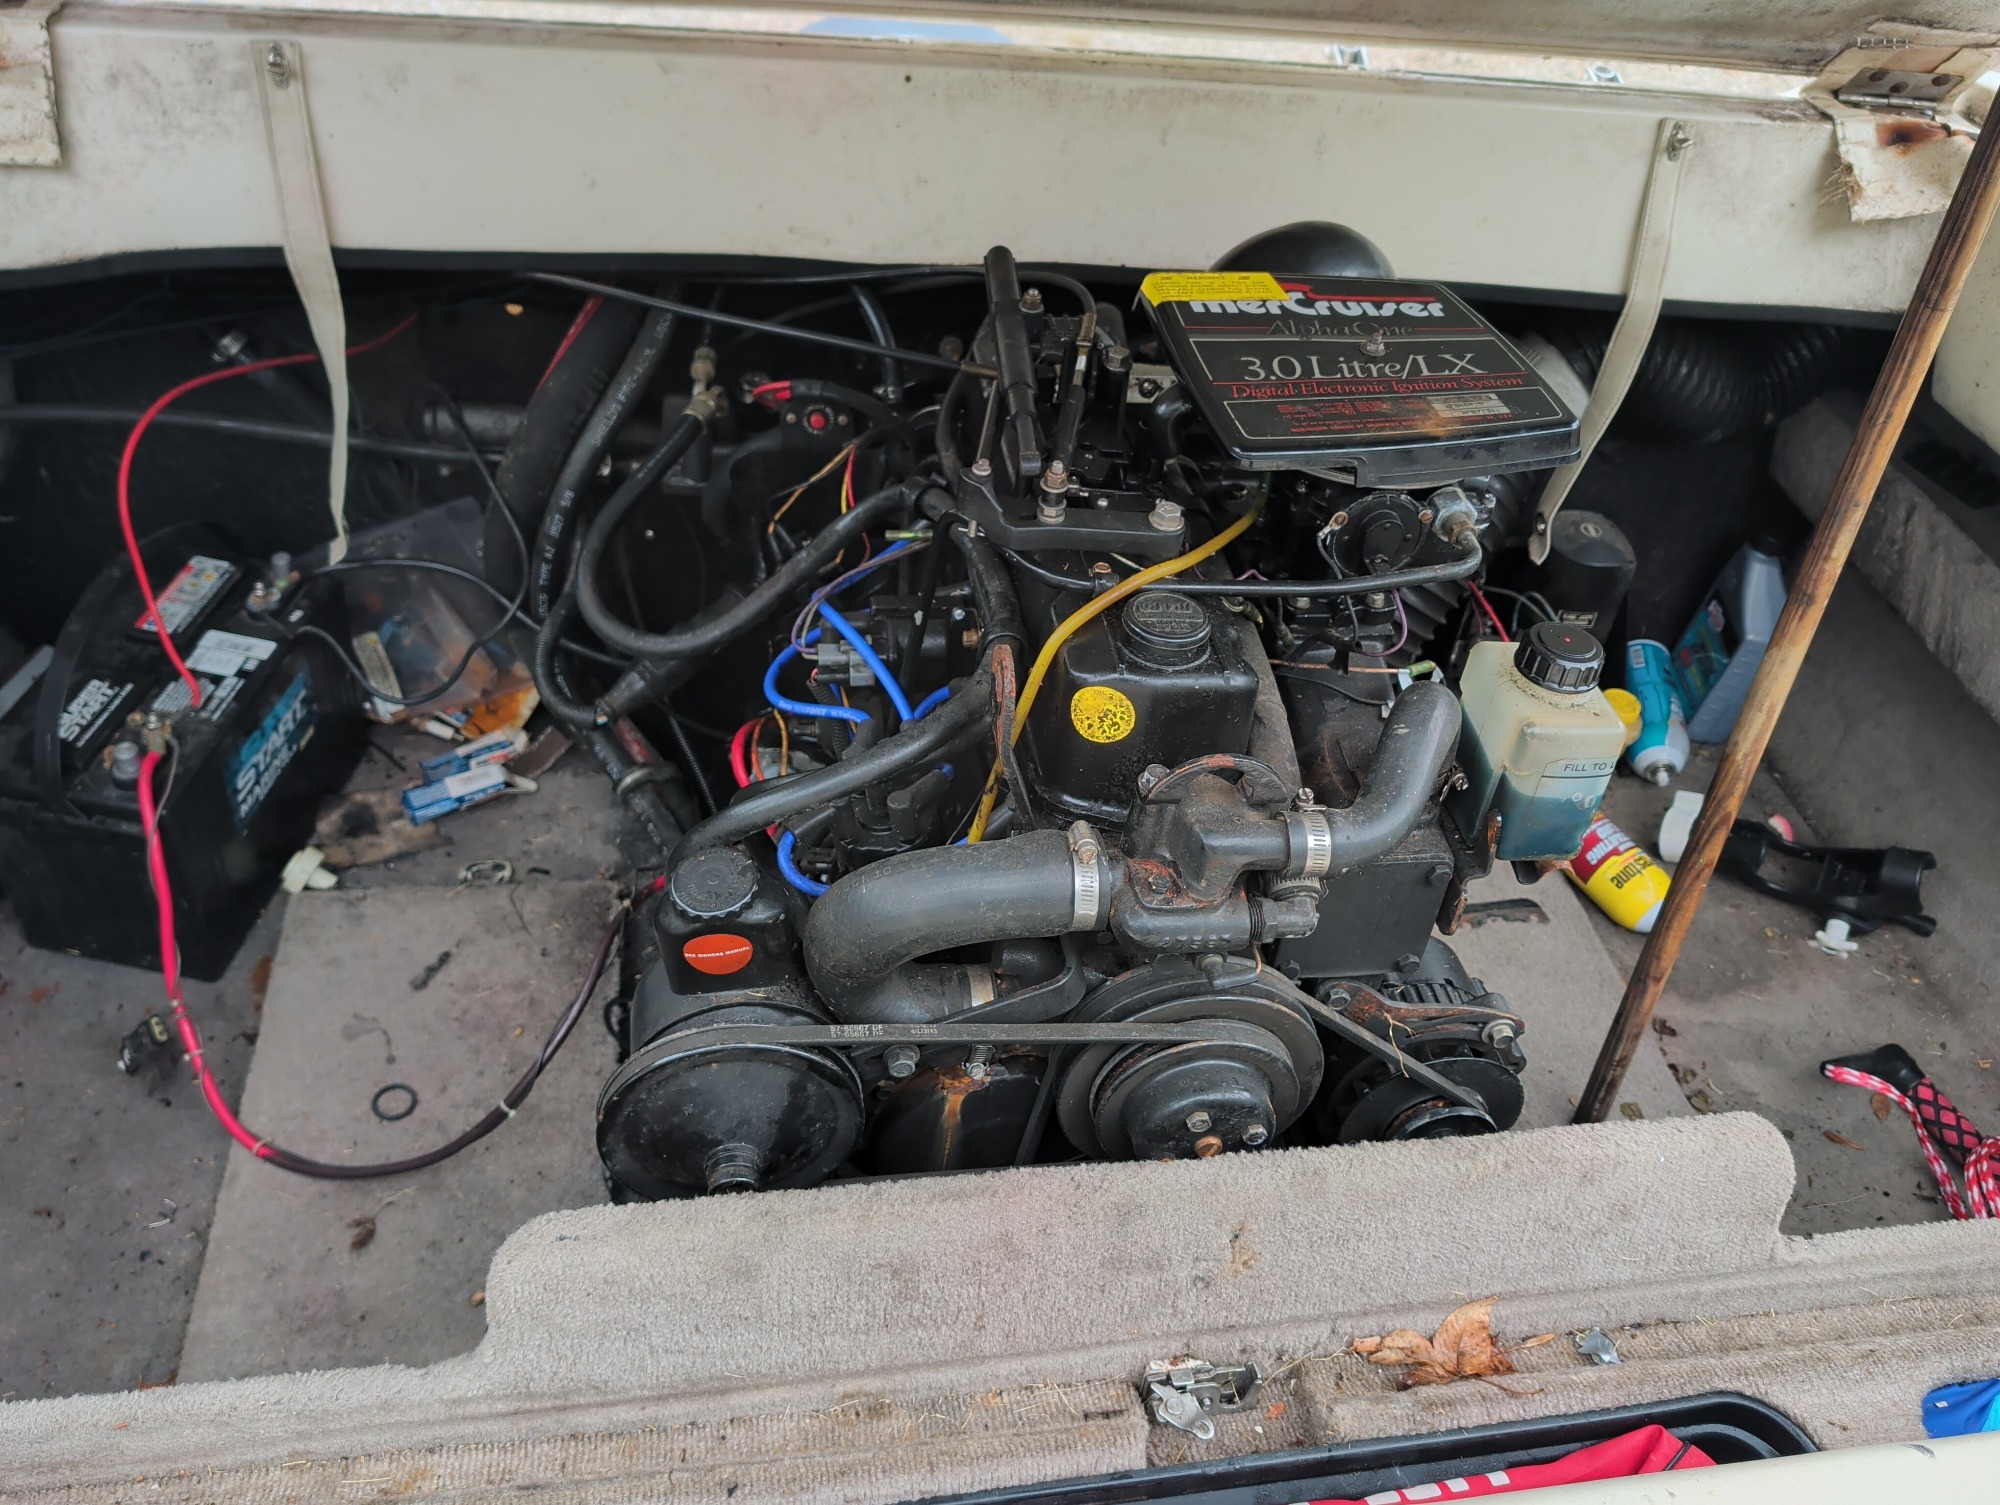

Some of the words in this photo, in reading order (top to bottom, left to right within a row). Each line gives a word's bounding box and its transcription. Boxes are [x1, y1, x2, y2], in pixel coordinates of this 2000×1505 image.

[1266, 319, 1348, 337] Alpha
[1240, 354, 1301, 382] 3.0
[1307, 352, 1488, 381] Litre/LX
[1232, 383, 1295, 400] Digital
[1301, 380, 1388, 397] Electronic
[1392, 377, 1457, 395] Ignition
[1461, 375, 1524, 391] System
[1093, 688, 1108, 697] OIL
[236, 688, 308, 802] START
[1563, 762, 1588, 772] FILL
[1592, 762, 1608, 771] TO
[1610, 855, 1655, 890] restone
[684, 951, 697, 959] SEE
[697, 950, 724, 959] OWNERS
[725, 945, 752, 957] MANUAL
